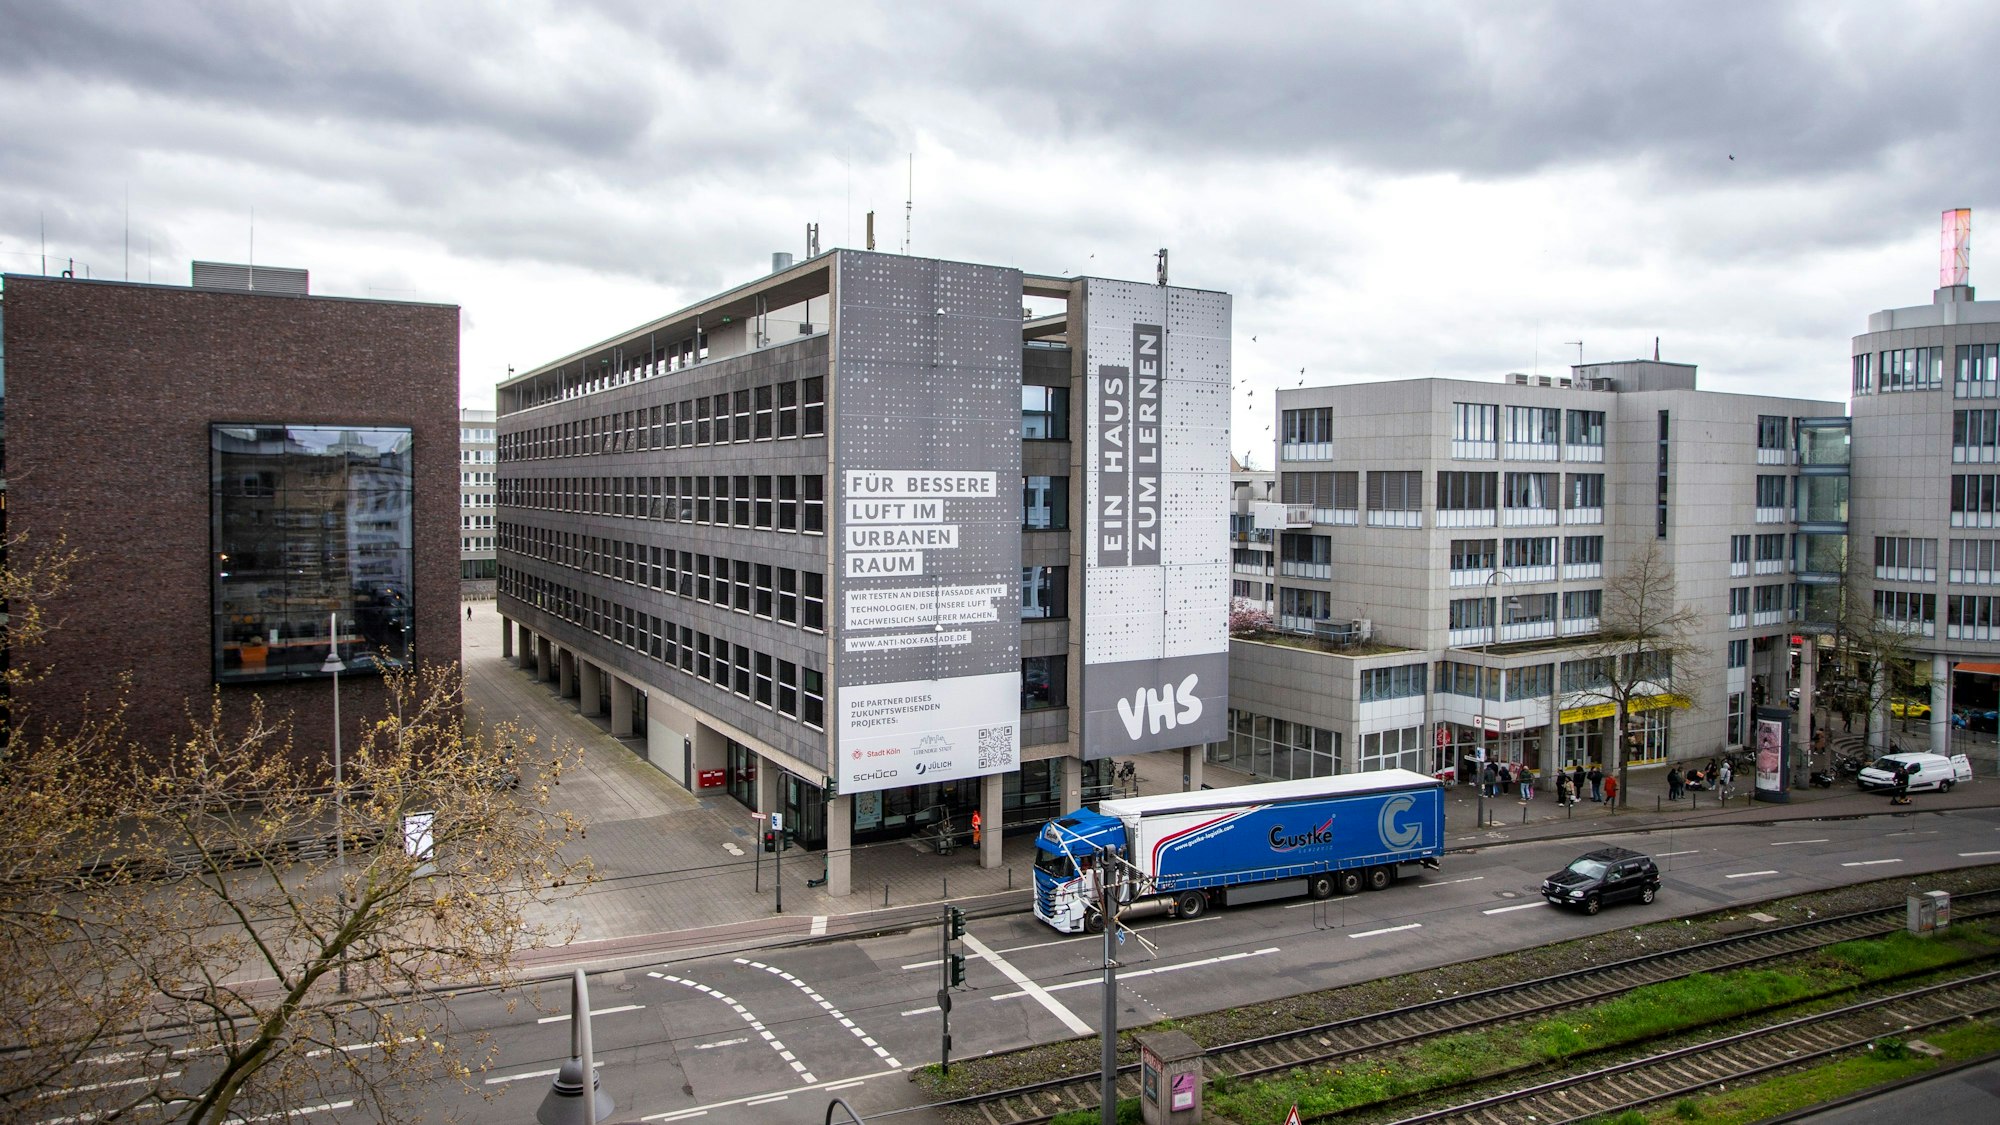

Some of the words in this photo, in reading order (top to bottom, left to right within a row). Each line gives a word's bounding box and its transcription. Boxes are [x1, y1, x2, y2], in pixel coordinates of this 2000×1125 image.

[1138, 334, 1158, 464] LERNEN
[1104, 376, 1124, 473] HAUS
[852, 472, 894, 492] FÜR
[908, 478, 990, 492] BESSERE
[852, 504, 906, 520] LUFT
[914, 503, 936, 518] IM
[1138, 476, 1157, 551] ZUM
[1104, 494, 1123, 552] EIN
[852, 530, 950, 546] URBANEN
[852, 556, 914, 573] RAUM
[942, 588, 974, 597] FASSADE
[976, 587, 1002, 596] AKTIVE
[851, 603, 918, 614] TECHNOLOGIEN,
[920, 602, 932, 610] DIE
[936, 601, 966, 609] UNSERE
[968, 600, 986, 608] LUFT
[851, 616, 915, 626] NACHWEISLICH
[917, 614, 958, 622] SAUBERER
[960, 612, 994, 620] MACHEN.
[850, 634, 967, 648] WWW.ANTI-NOX-FASSADE.DE
[851, 700, 865, 708] DIE
[866, 697, 904, 708] PARTNER
[905, 694, 932, 704] DIESES
[1118, 673, 1202, 740] VHS
[851, 703, 940, 718] ZUKUNFTSWEISENDEN
[851, 717, 898, 728] PROJEKTES:
[866, 750, 884, 758] Stadt
[886, 748, 900, 756] Köln
[928, 760, 952, 770] JÜLICH
[853, 770, 898, 782] SCHÜCO
[1174, 824, 1234, 852] www.gustke-logistik.com
[1268, 819, 1334, 848] Gustke
